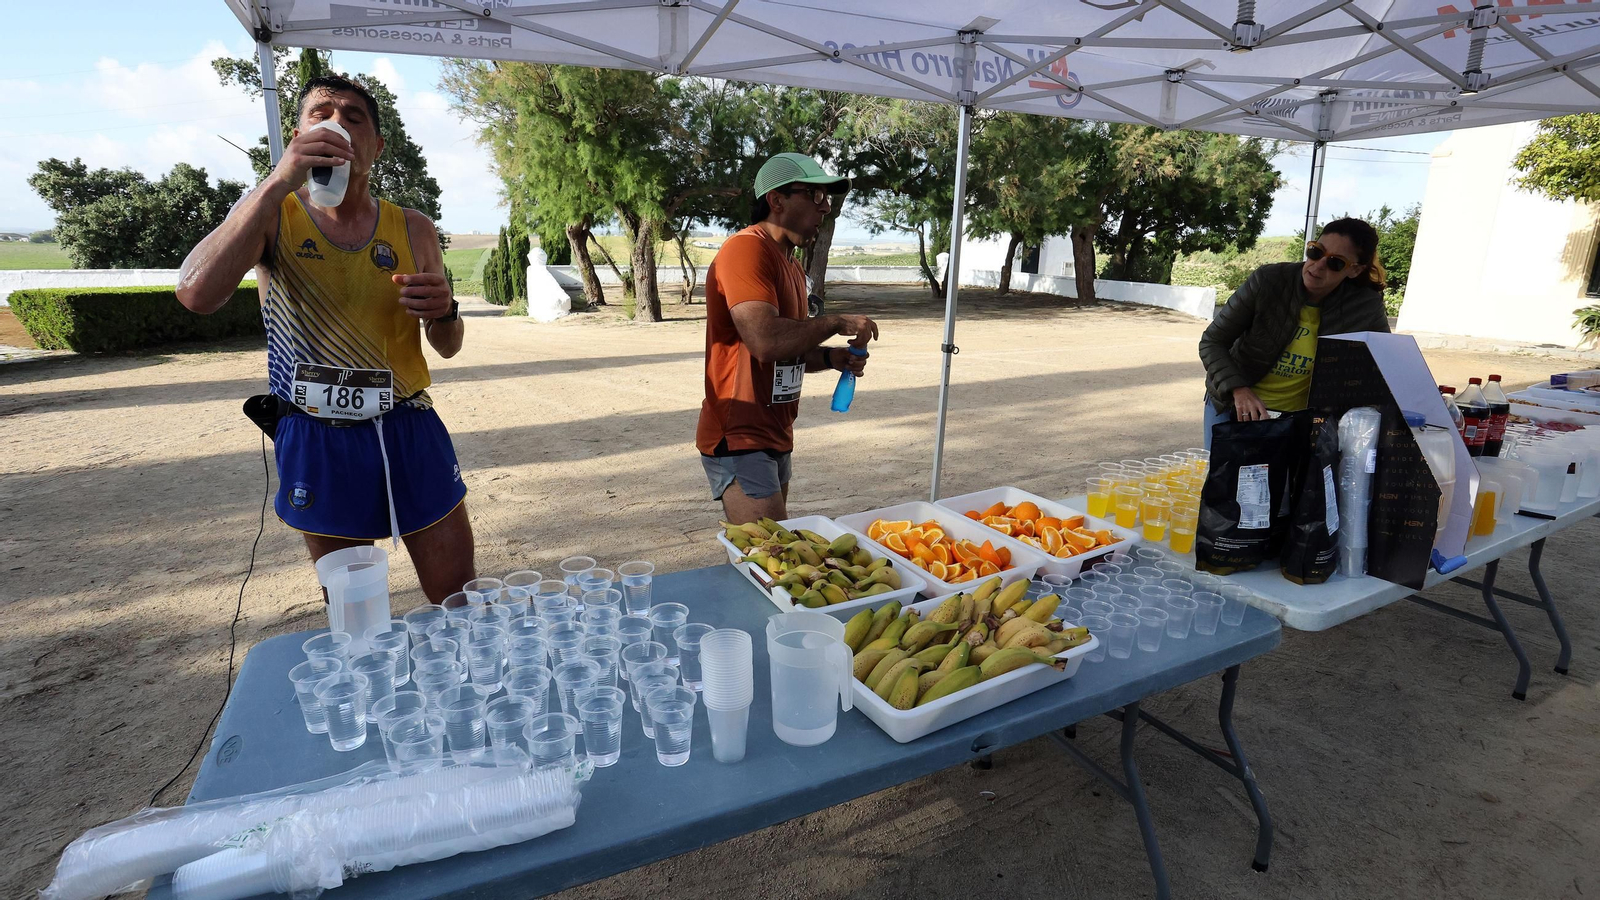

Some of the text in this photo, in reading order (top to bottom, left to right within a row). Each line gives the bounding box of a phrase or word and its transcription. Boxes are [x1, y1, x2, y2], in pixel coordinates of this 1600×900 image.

[322, 385, 365, 410] 186
[331, 410, 364, 418] PACHECO
[1387, 429, 1407, 437] HSN
[1403, 520, 1425, 528] HSN
